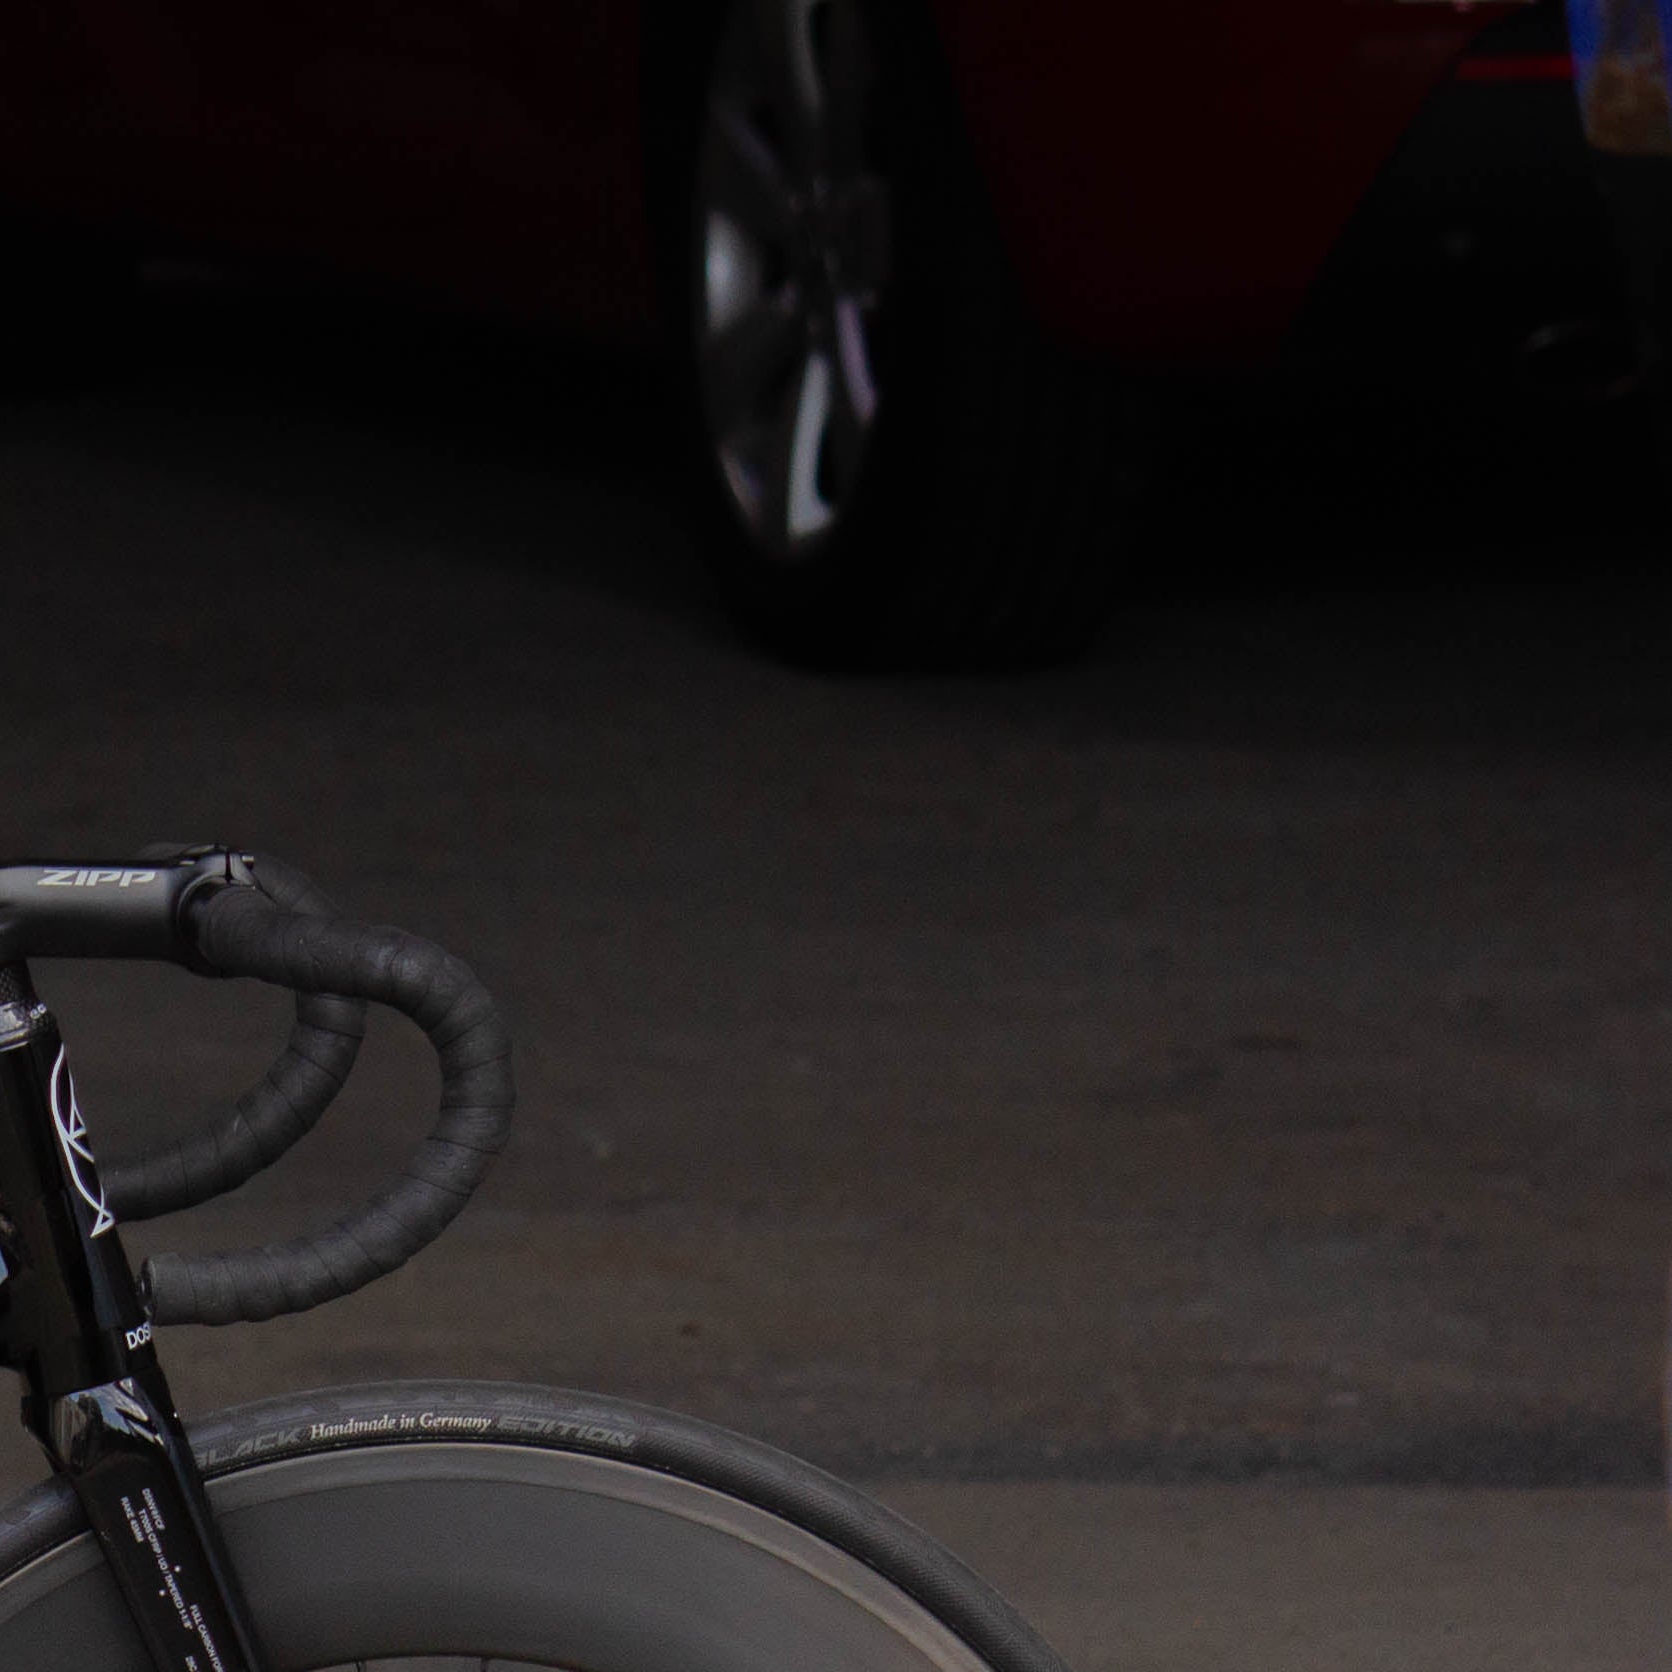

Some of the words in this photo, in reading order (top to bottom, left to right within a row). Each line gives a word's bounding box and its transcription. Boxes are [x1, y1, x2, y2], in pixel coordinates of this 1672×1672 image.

[37, 867, 156, 889] ZIPP
[310, 1416, 398, 1441] Handmade
[400, 1413, 416, 1429] in
[420, 1411, 493, 1434] Germany
